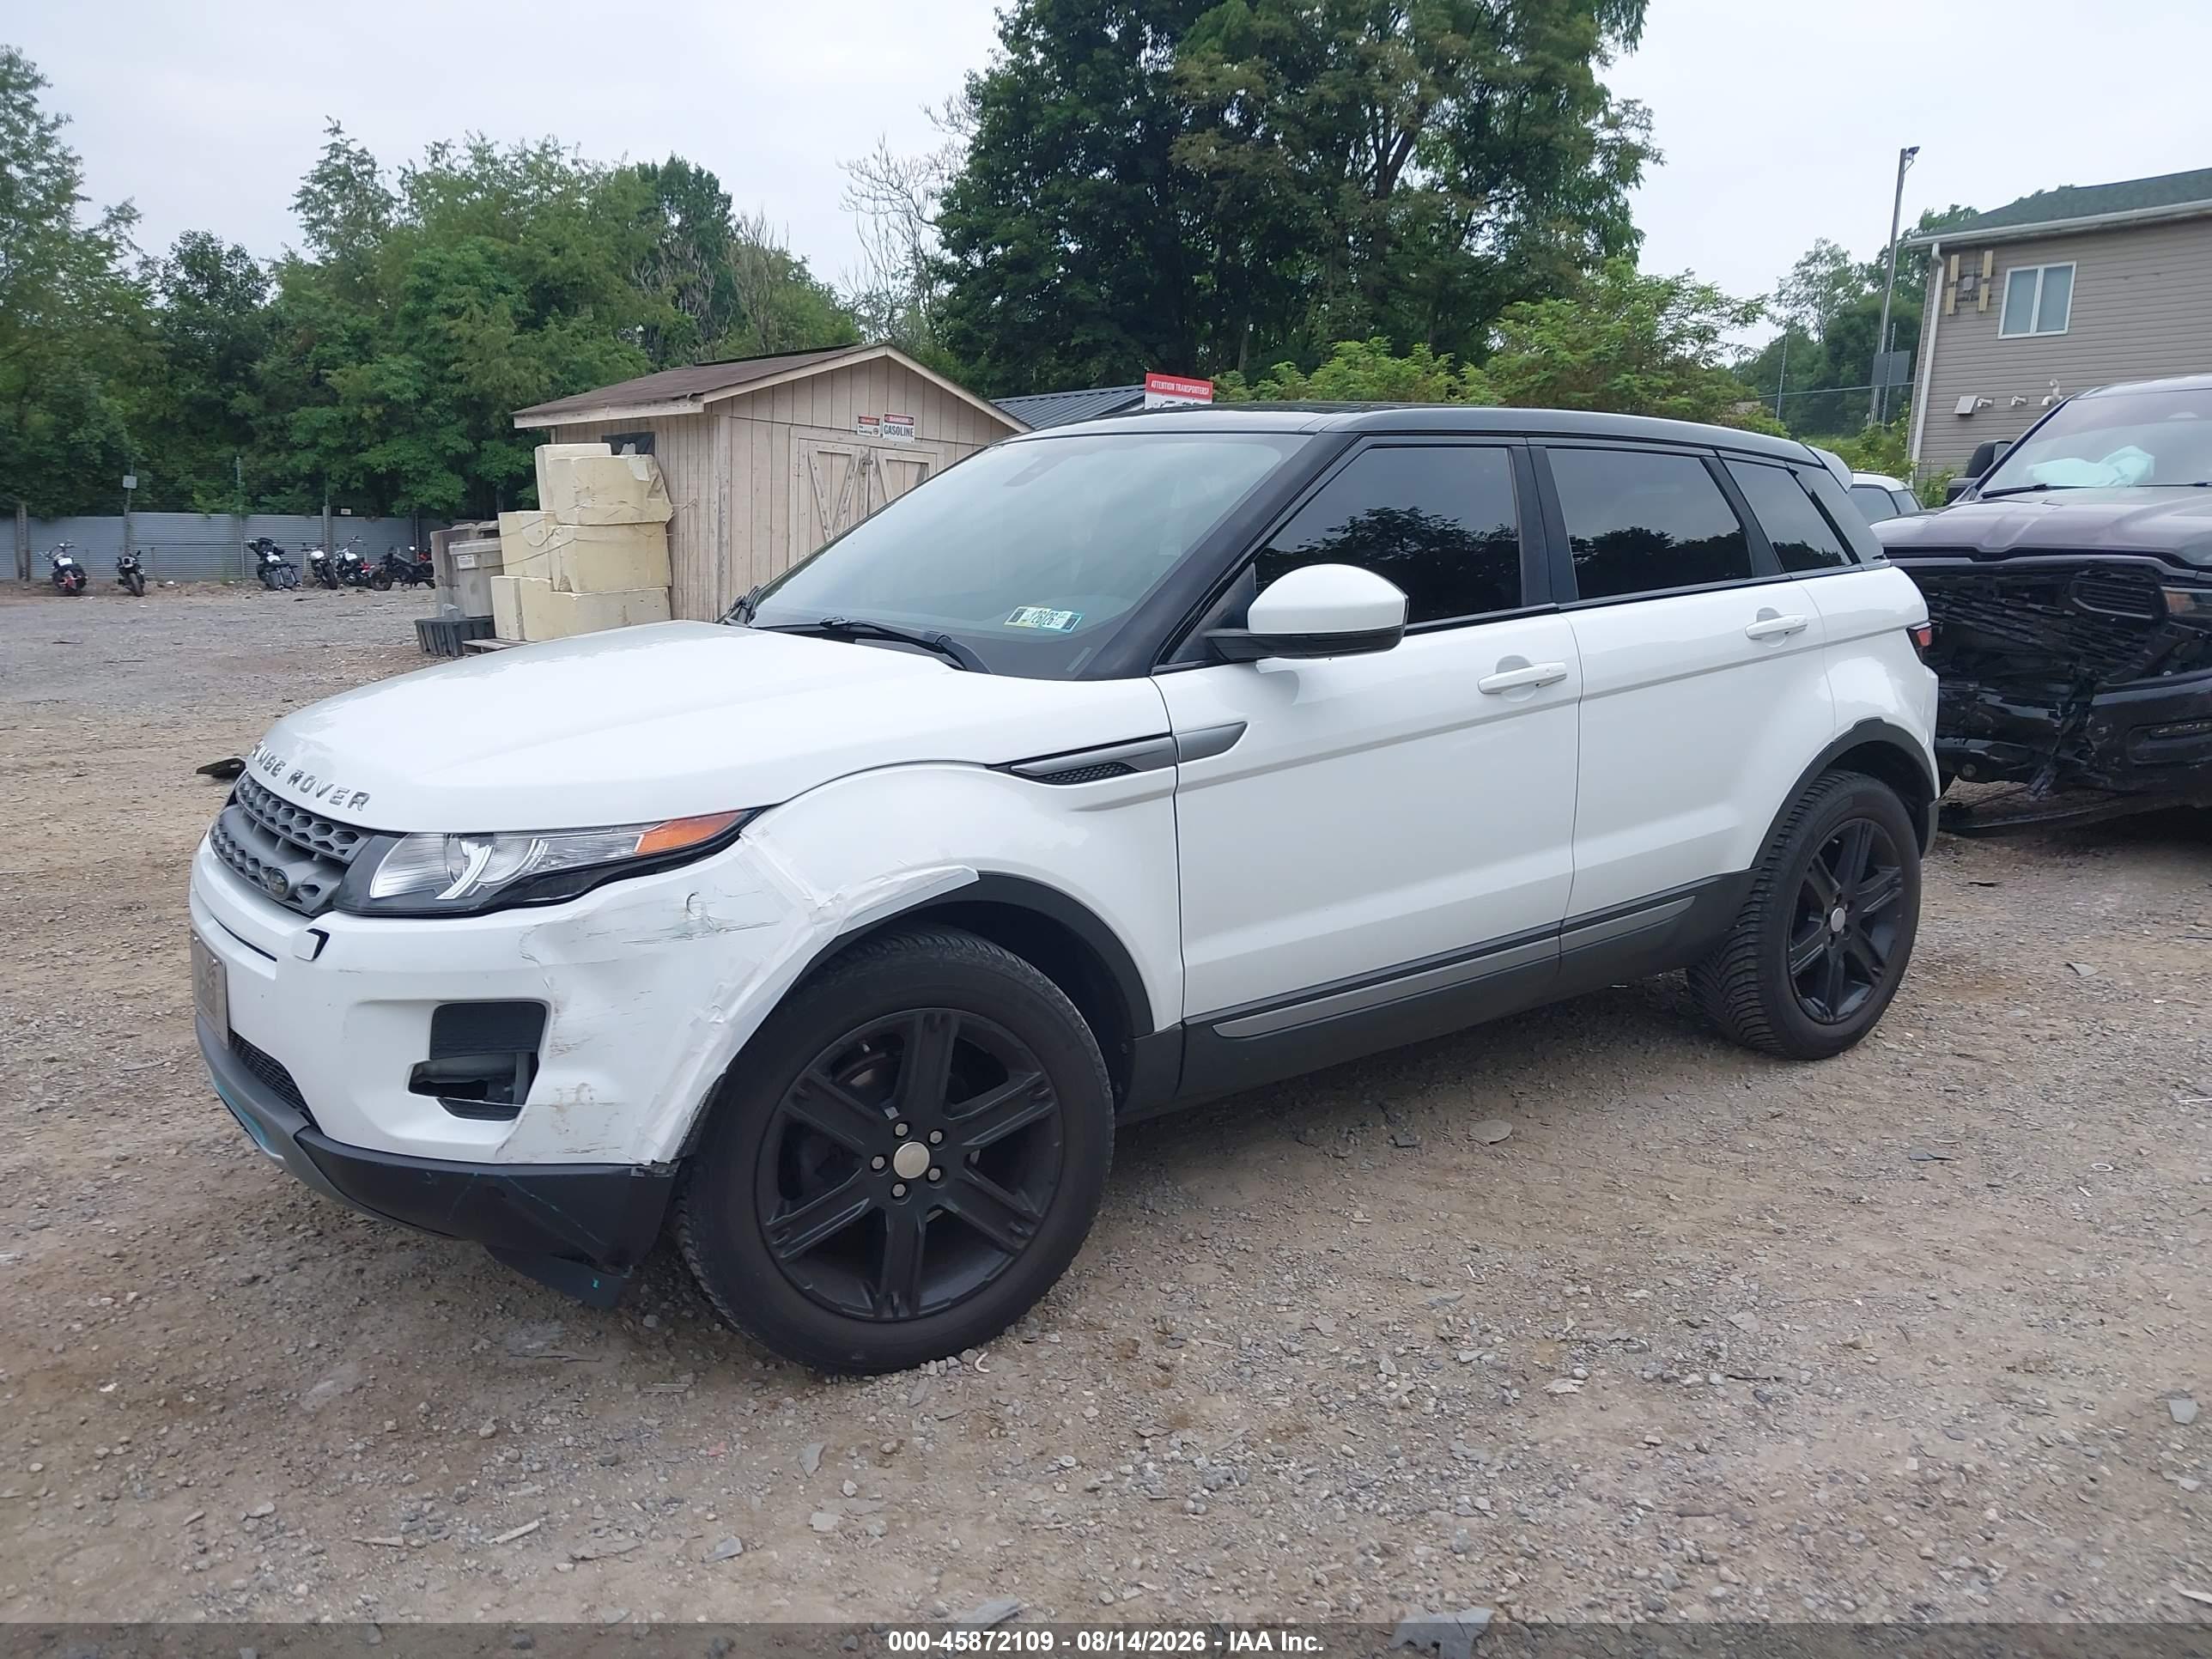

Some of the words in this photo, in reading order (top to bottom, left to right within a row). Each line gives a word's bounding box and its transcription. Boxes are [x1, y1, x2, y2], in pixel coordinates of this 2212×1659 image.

[1151, 380, 1175, 391] ATTENTION
[884, 424, 914, 437] GASOLINE
[287, 769, 371, 811] ROVER
